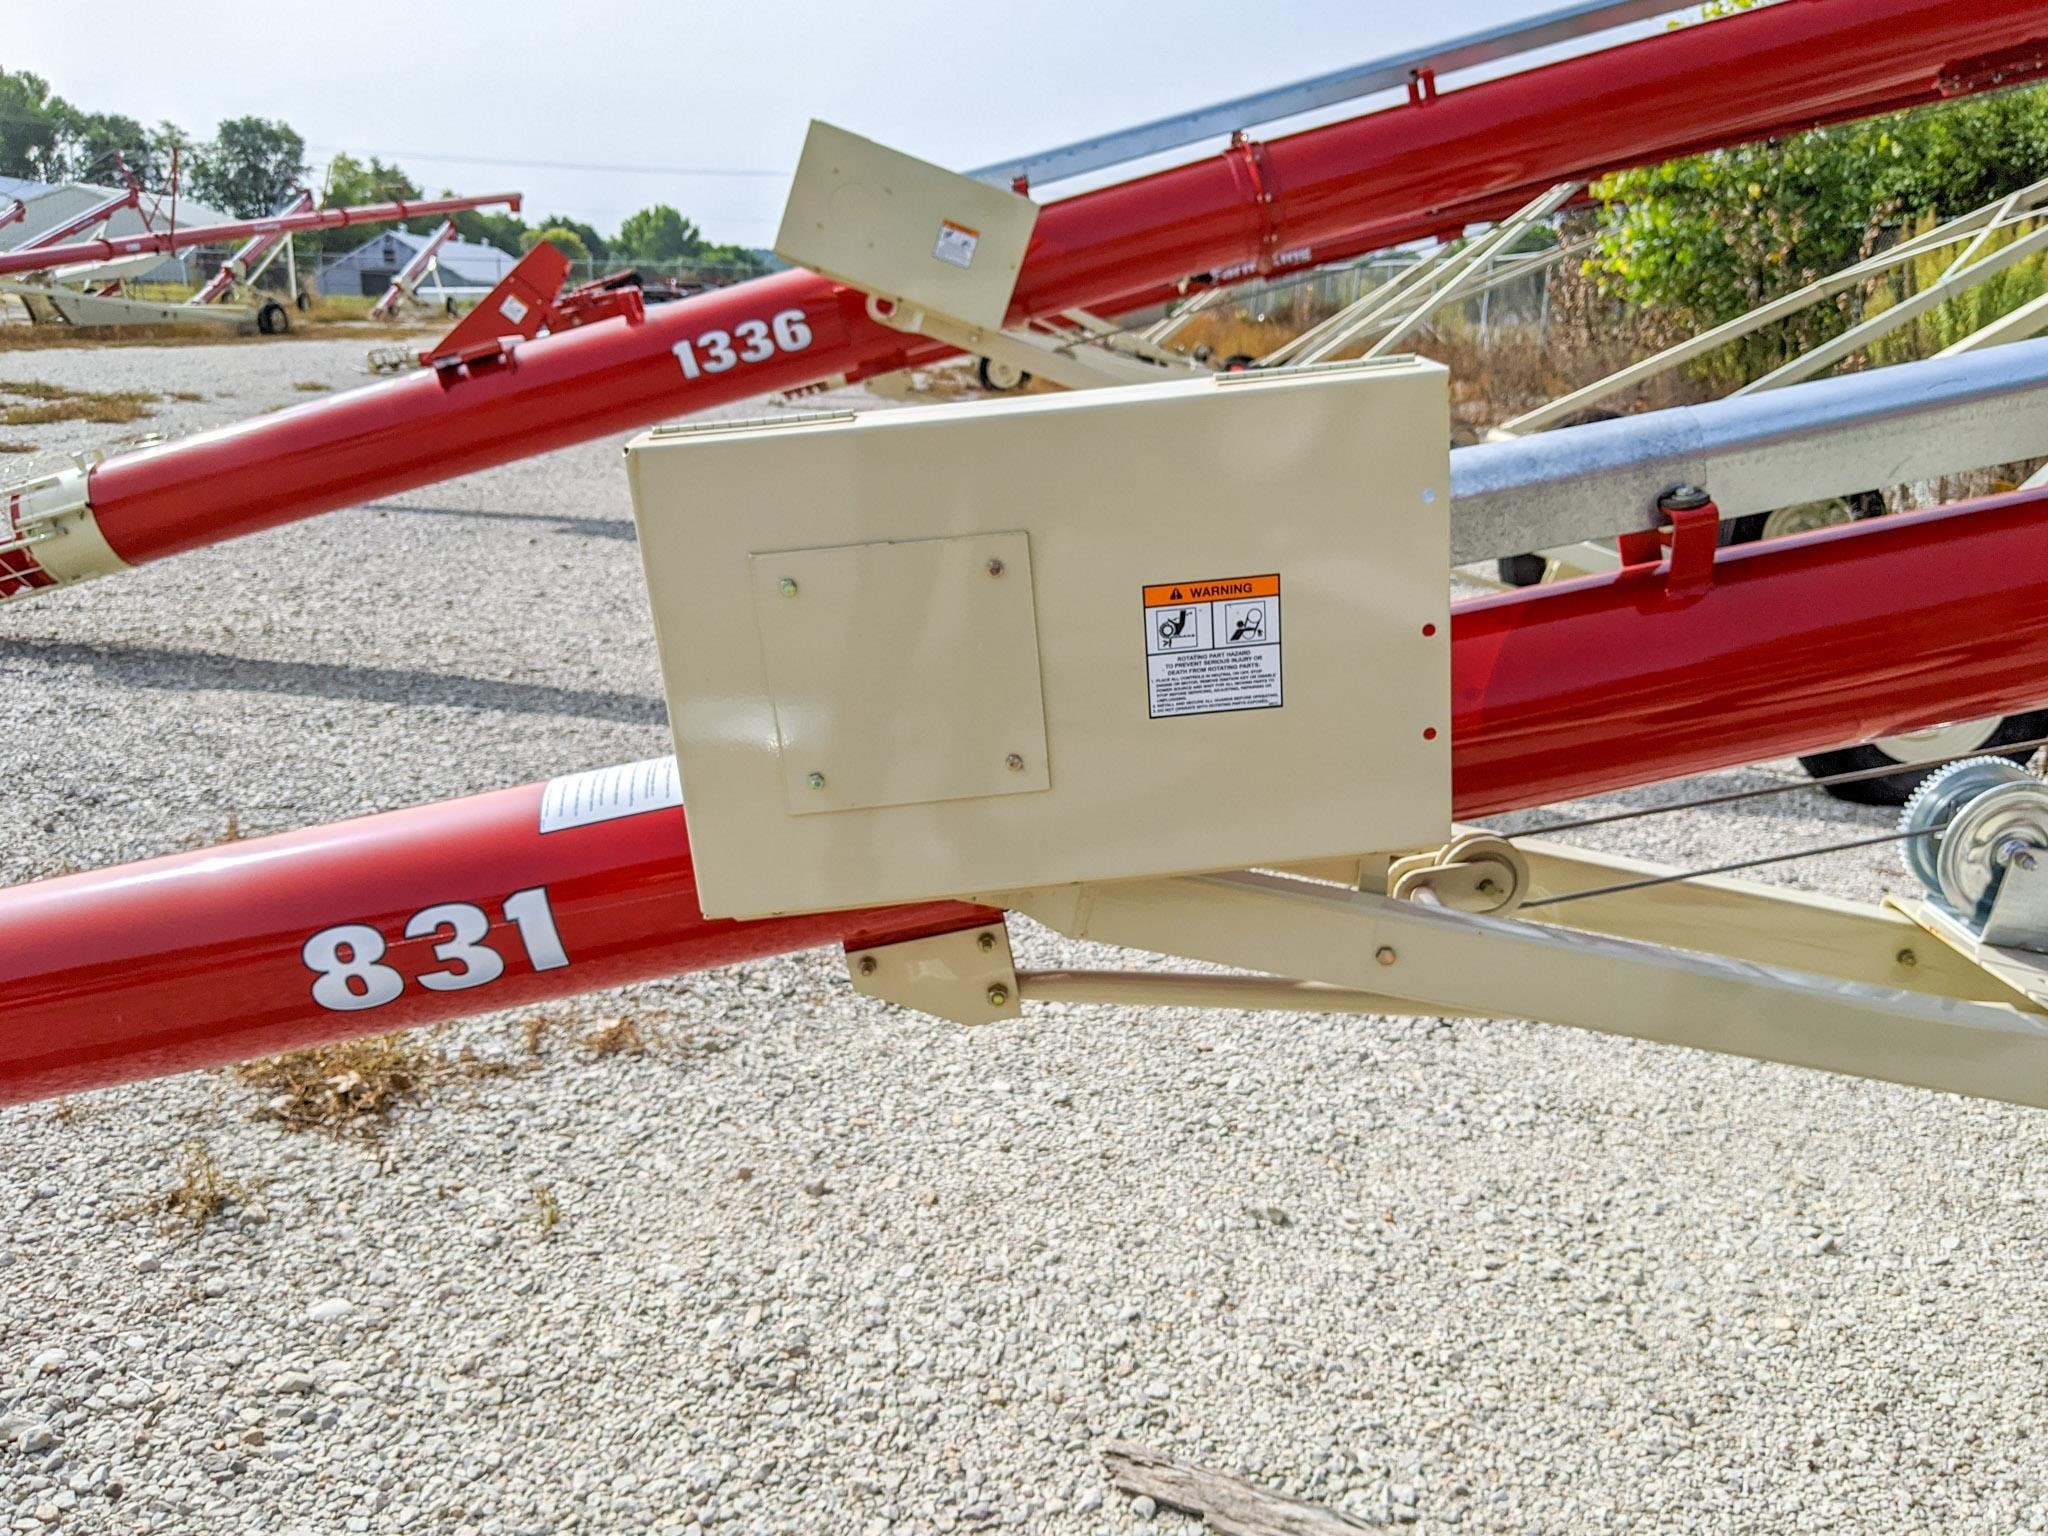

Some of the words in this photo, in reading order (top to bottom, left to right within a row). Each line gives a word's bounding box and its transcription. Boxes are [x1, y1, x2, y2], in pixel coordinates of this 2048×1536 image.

[672, 307, 813, 380] 1336
[1190, 583, 1252, 598] WARNING
[1177, 654, 1208, 662] ROTATING
[1208, 664, 1238, 672] ROTATING
[302, 885, 570, 1012] 831
